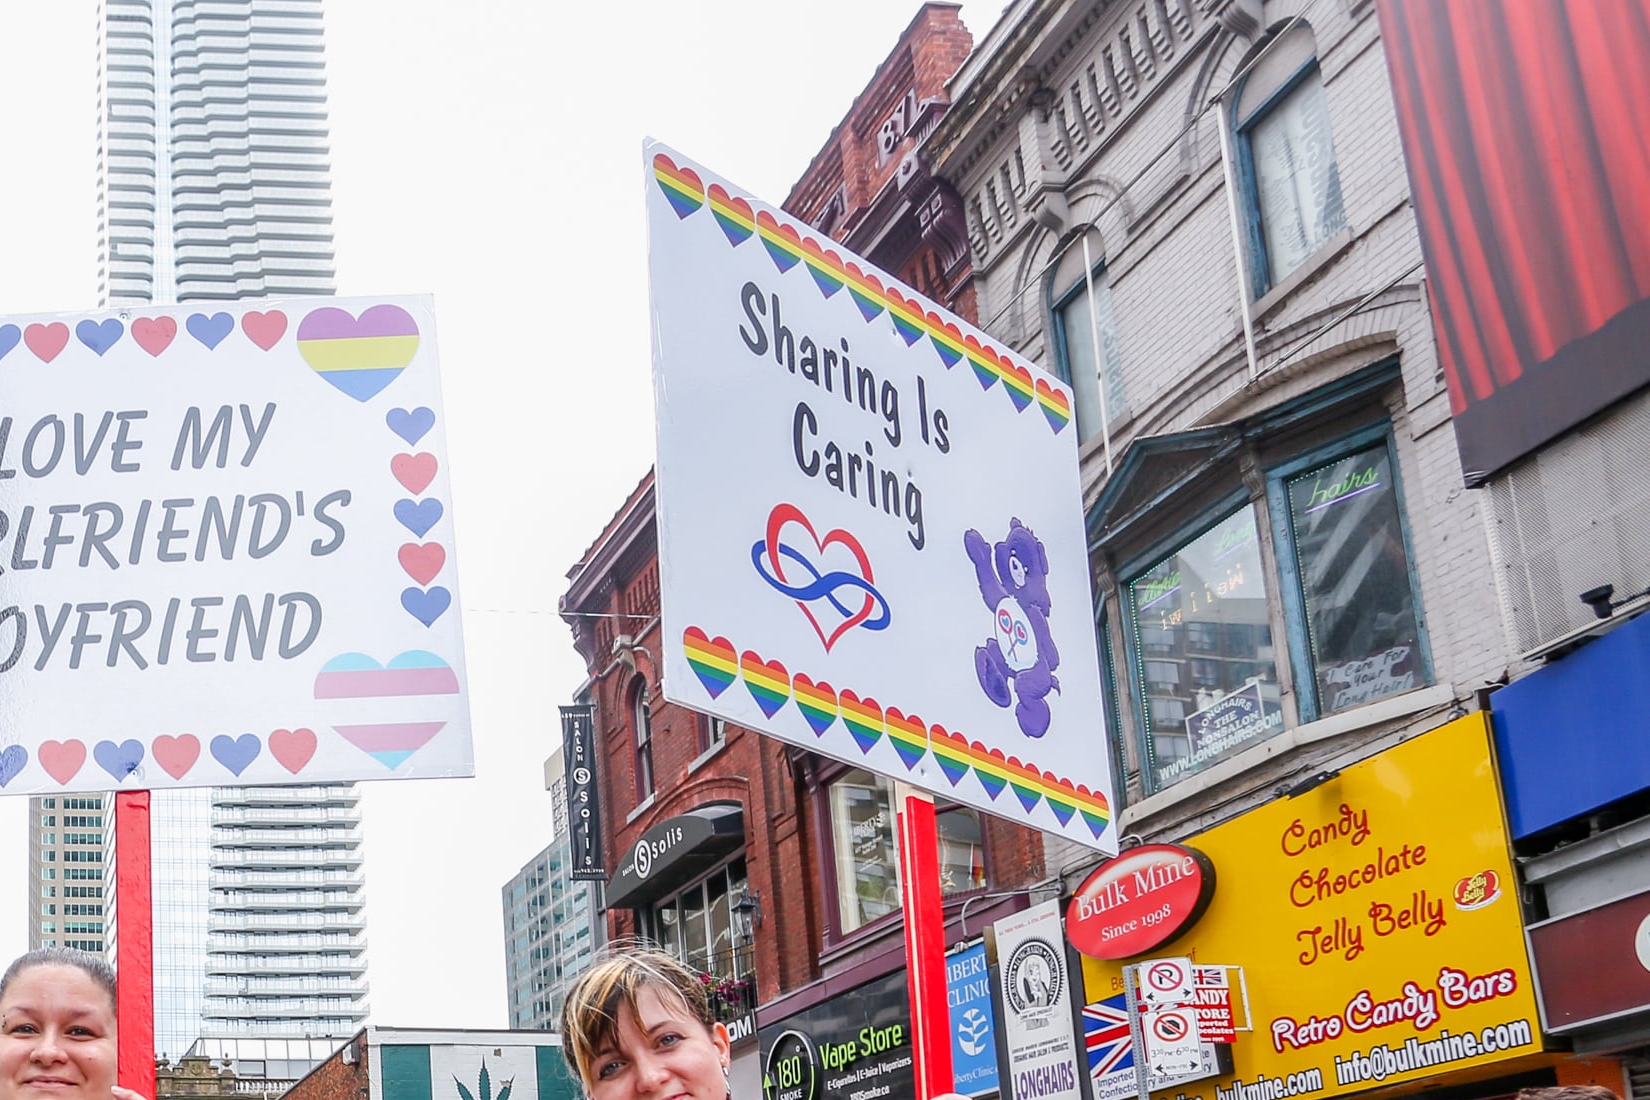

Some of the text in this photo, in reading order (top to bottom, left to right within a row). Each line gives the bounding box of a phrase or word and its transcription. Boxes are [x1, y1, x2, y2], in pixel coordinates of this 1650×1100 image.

[738, 281, 951, 455] Sharing Is
[171, 401, 276, 471] MY
[793, 401, 926, 551] Caring
[1197, 710, 1259, 749] NONSALON
[1198, 696, 1252, 735] LONGHAIRS
[1214, 710, 1237, 729] THE
[573, 721, 584, 761] SALON
[1281, 803, 1371, 857] Candy
[1075, 855, 1196, 922] Bulk Mine
[1289, 844, 1428, 907] Chocolate
[1461, 887, 1486, 903] Belly
[1466, 874, 1488, 891] Jelly
[1102, 903, 1172, 942] Since 1998
[1296, 890, 1447, 966] Jelly Belly
[946, 953, 988, 984] IBERT
[1183, 989, 1229, 1005] ANDY
[1196, 1007, 1230, 1019] TORE
[1270, 966, 1518, 1053] Retro Candy Bars
[727, 1016, 752, 1042] OM
[819, 1023, 903, 1072] Vape Store
[1335, 1018, 1532, 1087] info@bulkmine.com
[860, 1066, 879, 1080] E-Juice
[1014, 1059, 1075, 1100] LONGHAIRS
